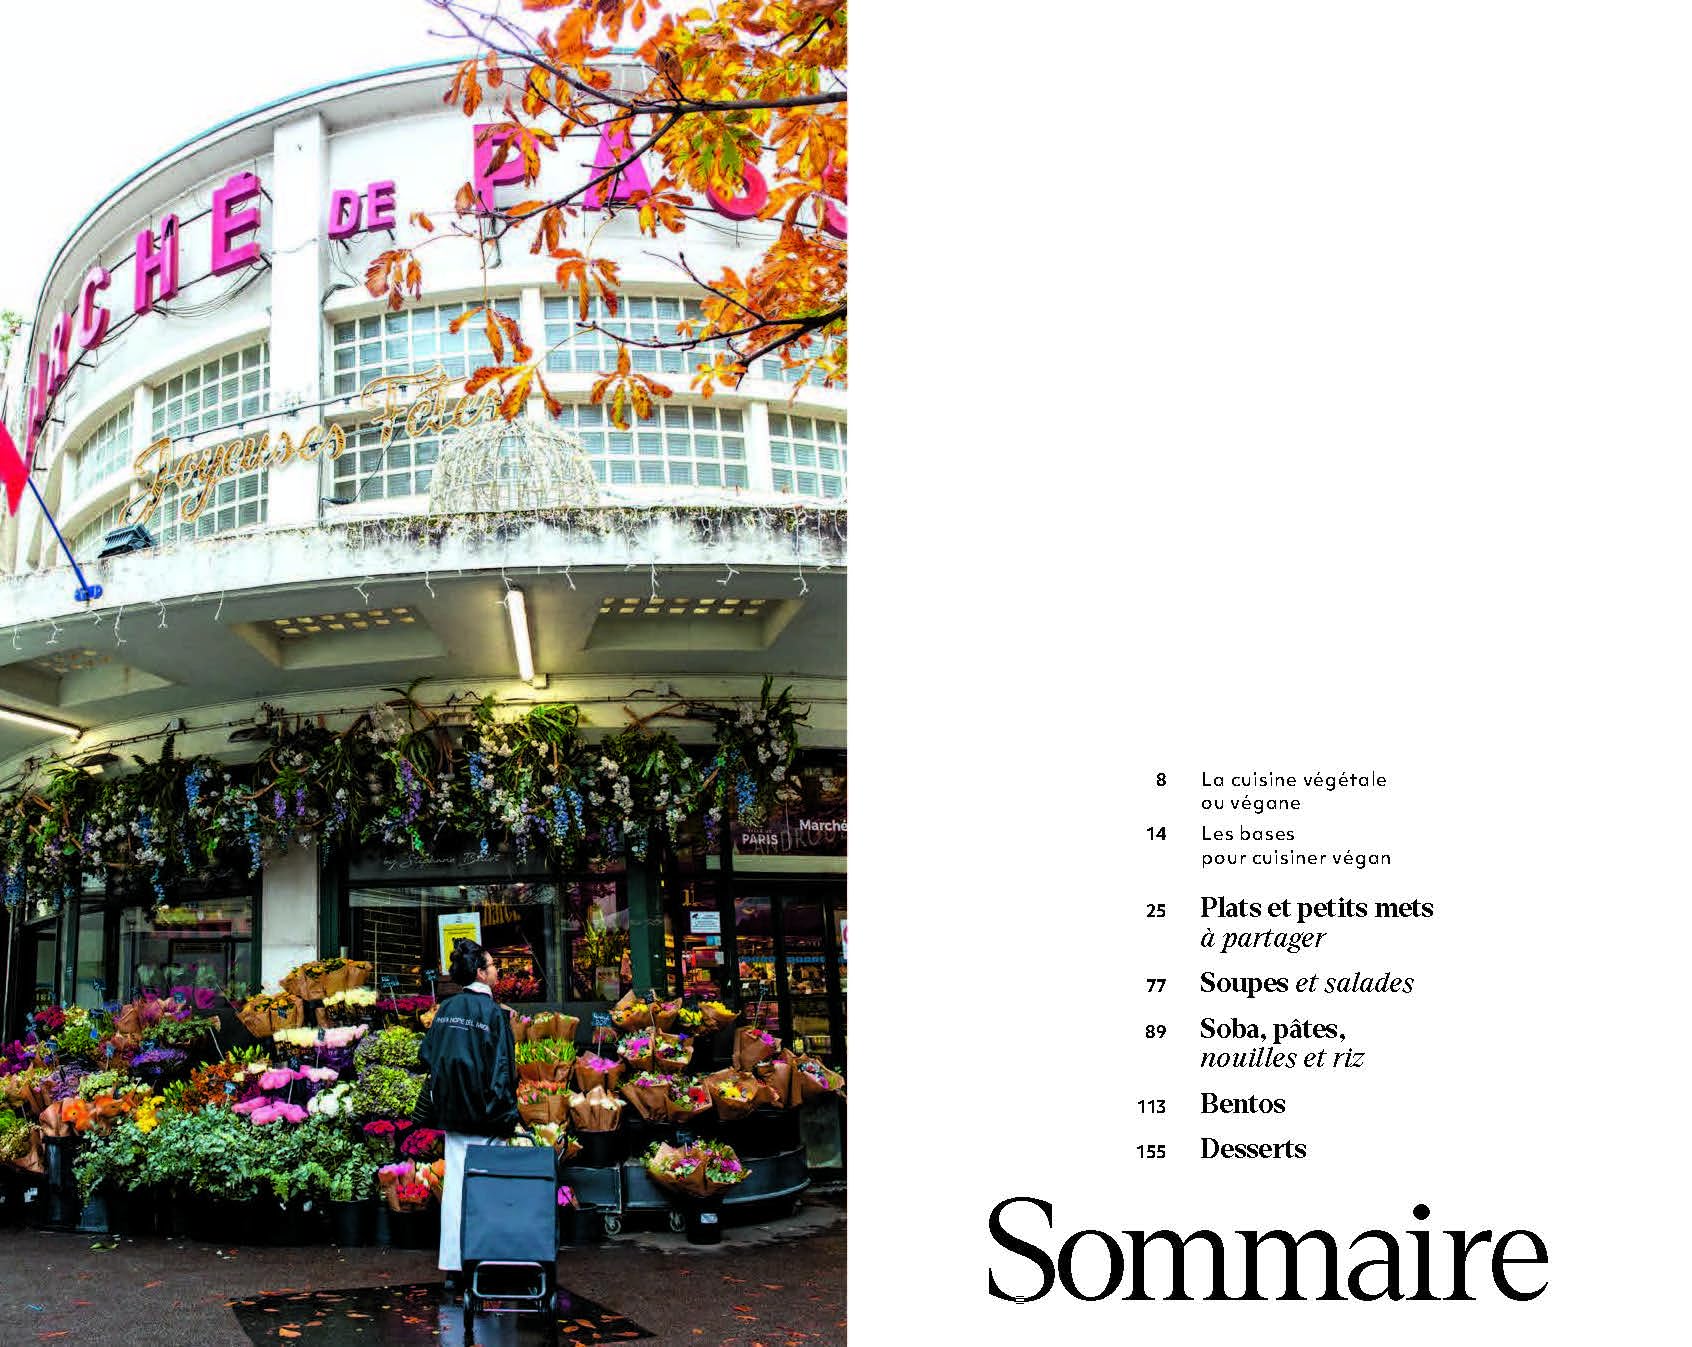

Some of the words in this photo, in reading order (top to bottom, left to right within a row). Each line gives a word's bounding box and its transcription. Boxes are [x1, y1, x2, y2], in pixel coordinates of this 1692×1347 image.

[24, 171, 262, 474] RCHÉ
[328, 179, 397, 241] DE
[118, 421, 346, 526] Joyeuses
[742, 834, 779, 845] PARIS
